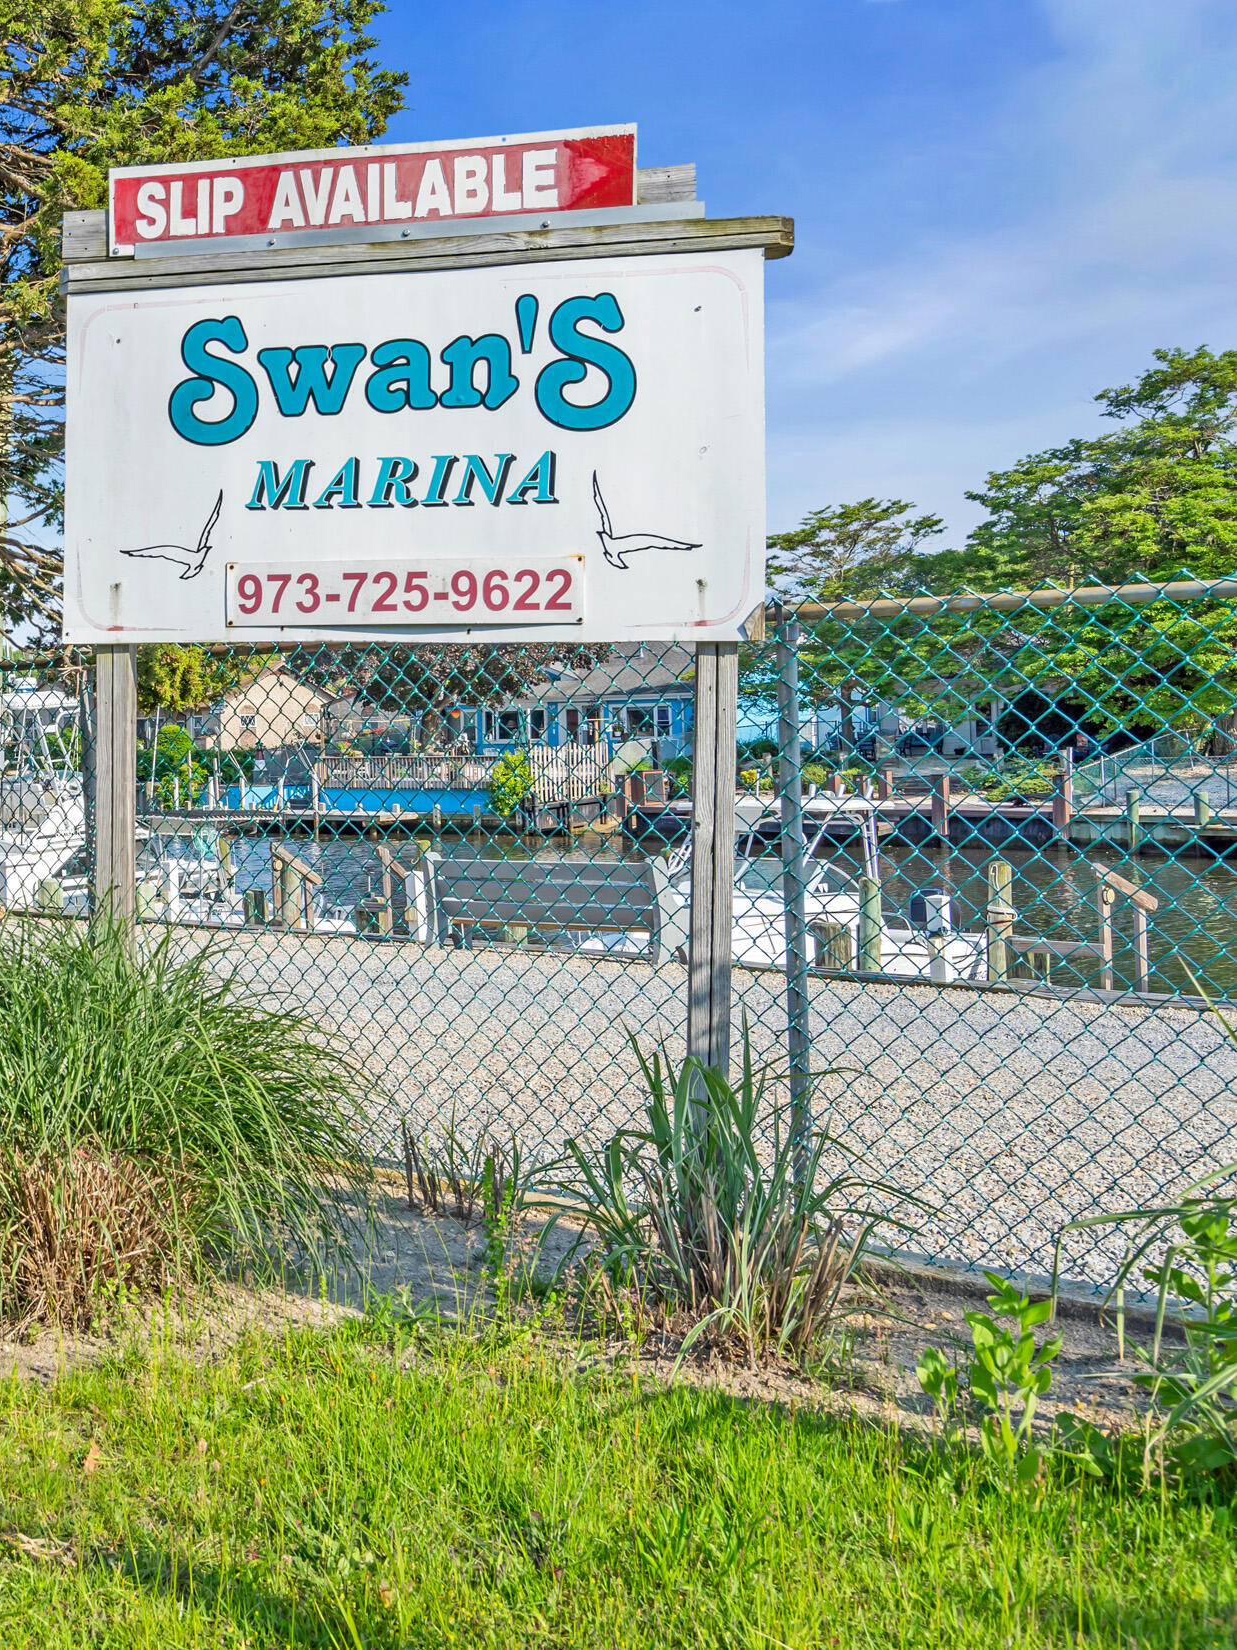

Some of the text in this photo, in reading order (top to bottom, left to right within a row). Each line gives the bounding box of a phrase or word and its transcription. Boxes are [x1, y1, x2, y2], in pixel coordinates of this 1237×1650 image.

[136, 149, 559, 239] SLIP AVAILABLE
[246, 451, 559, 511] MARINA
[238, 569, 573, 614] 973-725-9622
